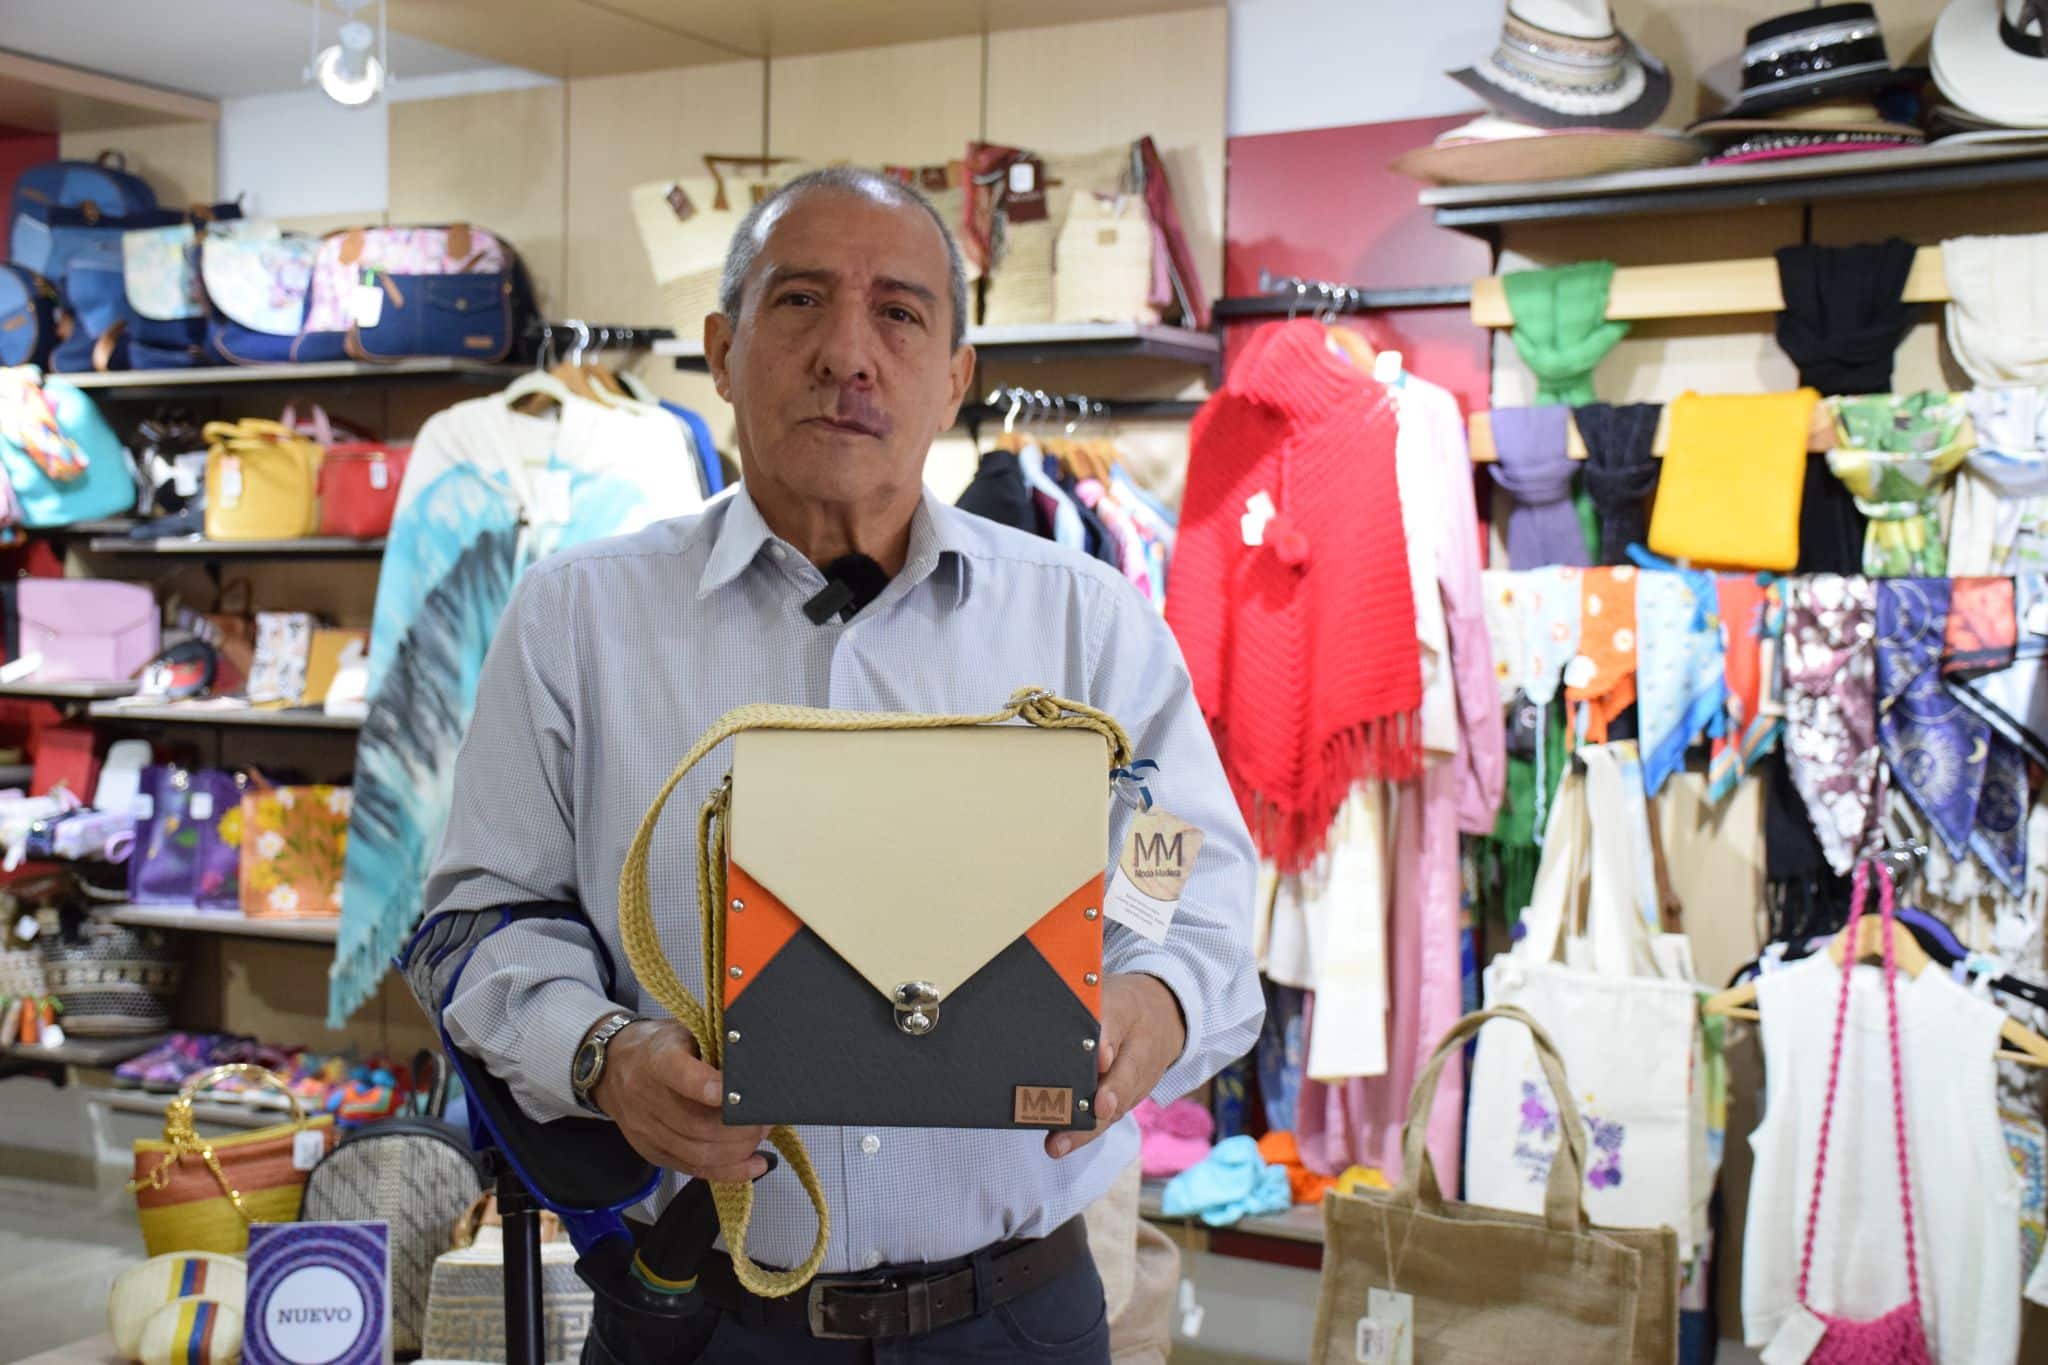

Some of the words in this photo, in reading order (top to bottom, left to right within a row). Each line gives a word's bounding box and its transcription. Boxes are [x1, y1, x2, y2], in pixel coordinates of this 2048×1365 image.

[1134, 832, 1183, 868] MM
[1022, 1088, 1066, 1114] MM
[278, 1306, 353, 1324] NUEVO
